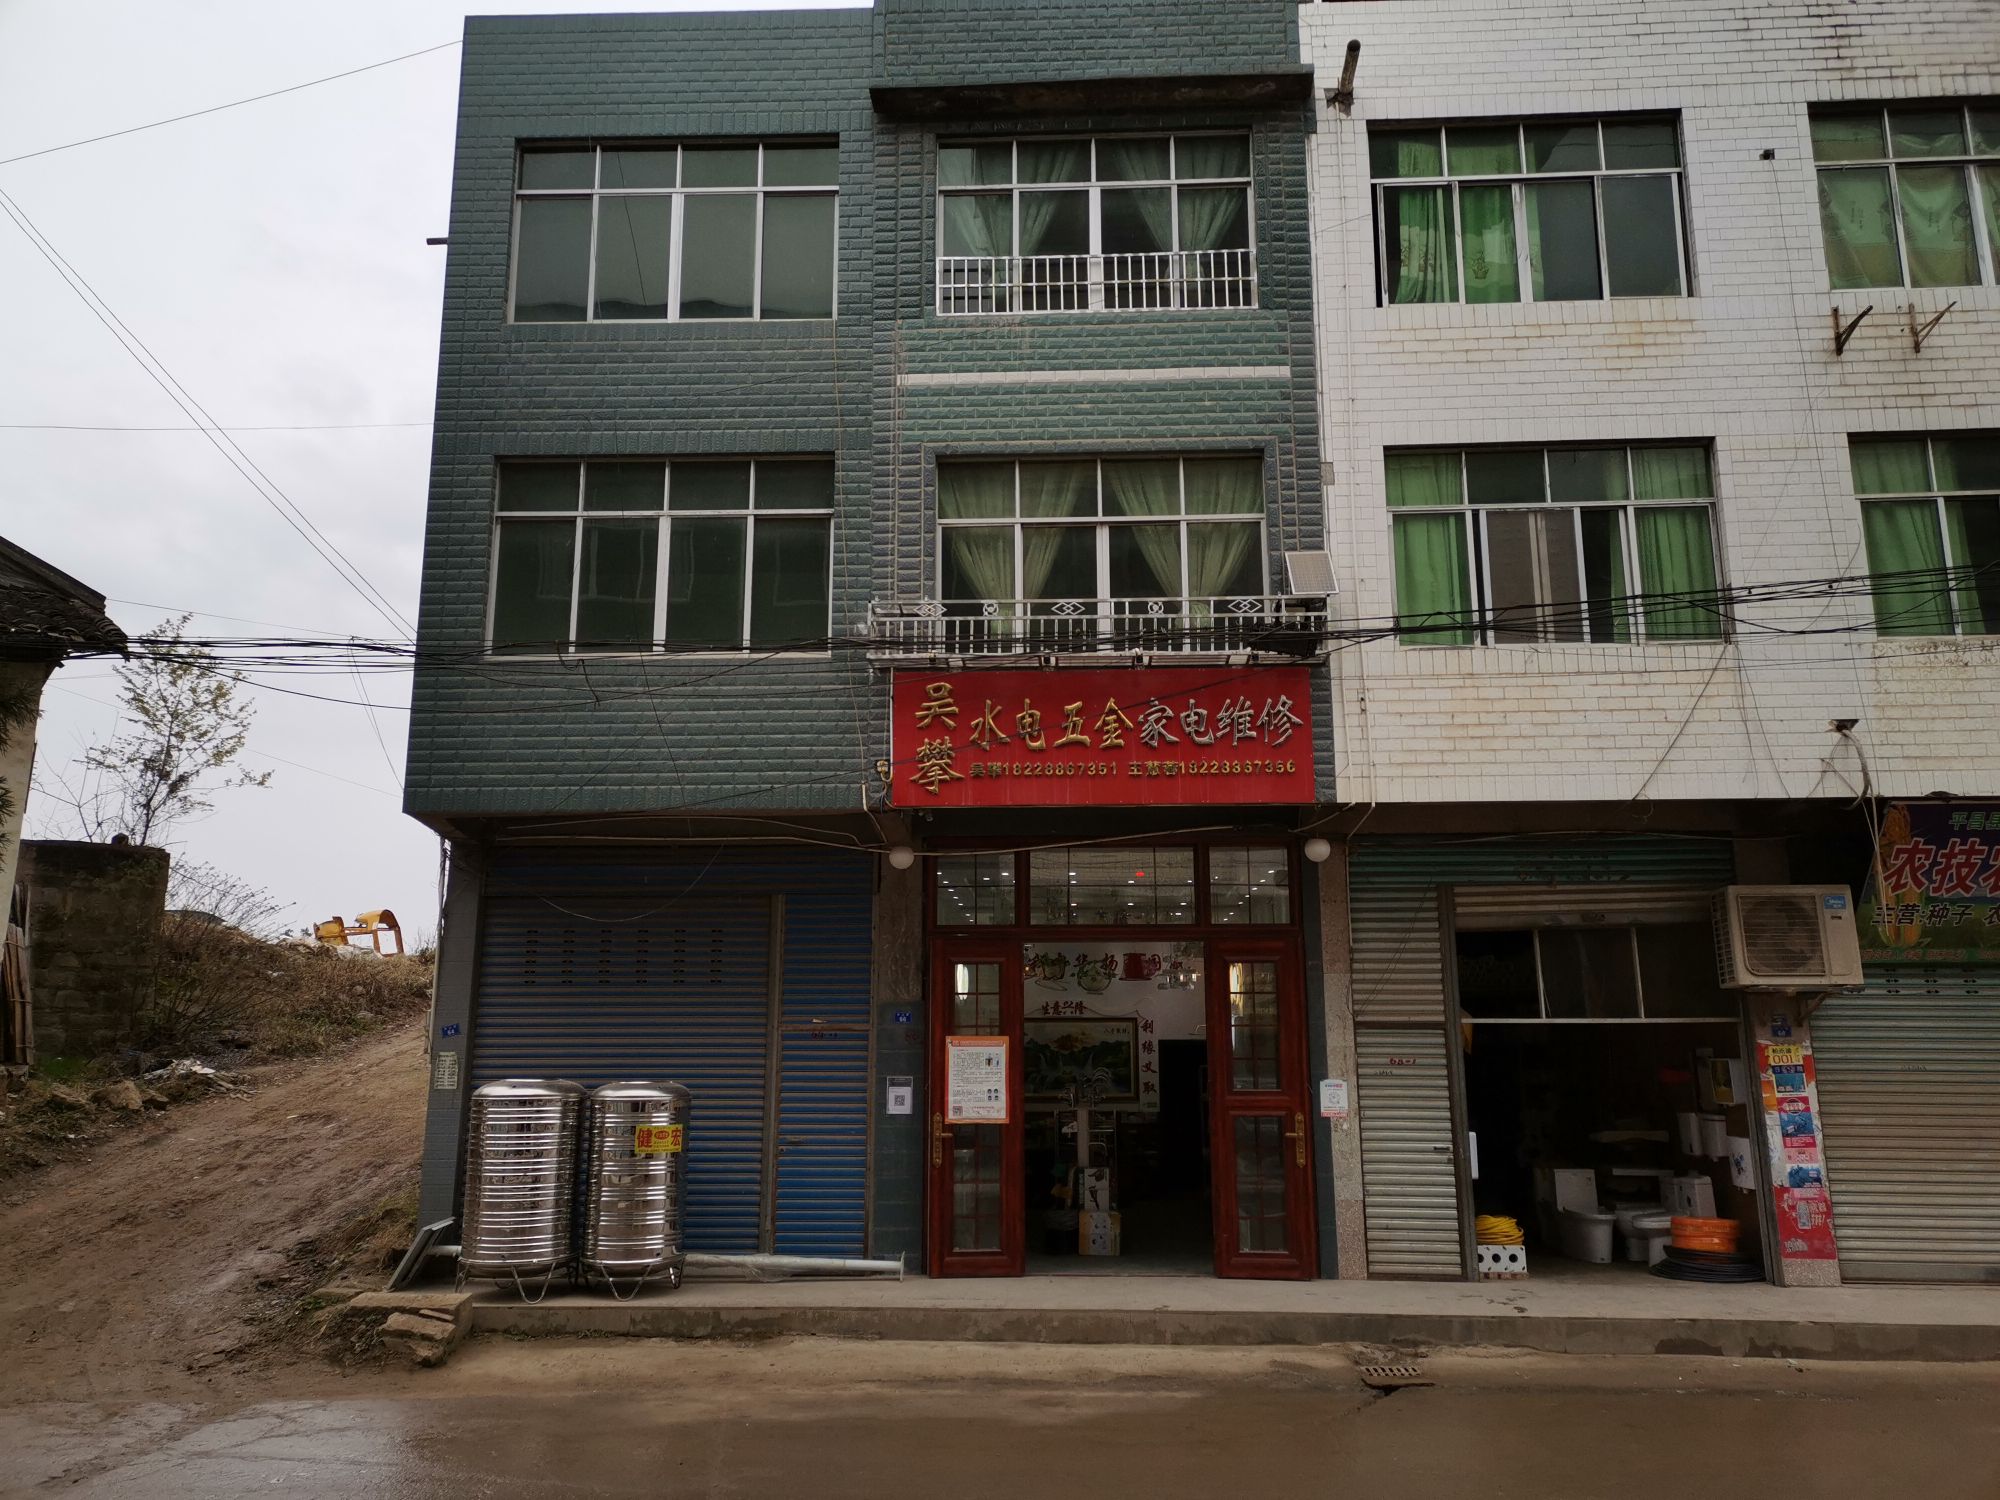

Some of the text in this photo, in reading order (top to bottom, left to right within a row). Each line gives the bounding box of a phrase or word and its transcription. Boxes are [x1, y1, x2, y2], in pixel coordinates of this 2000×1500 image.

[910, 681, 965, 794] 吴攀
[969, 696, 1304, 752] 水电五金家电维修
[637, 1127, 653, 1148] 健
[670, 1127, 682, 1147] 宏
